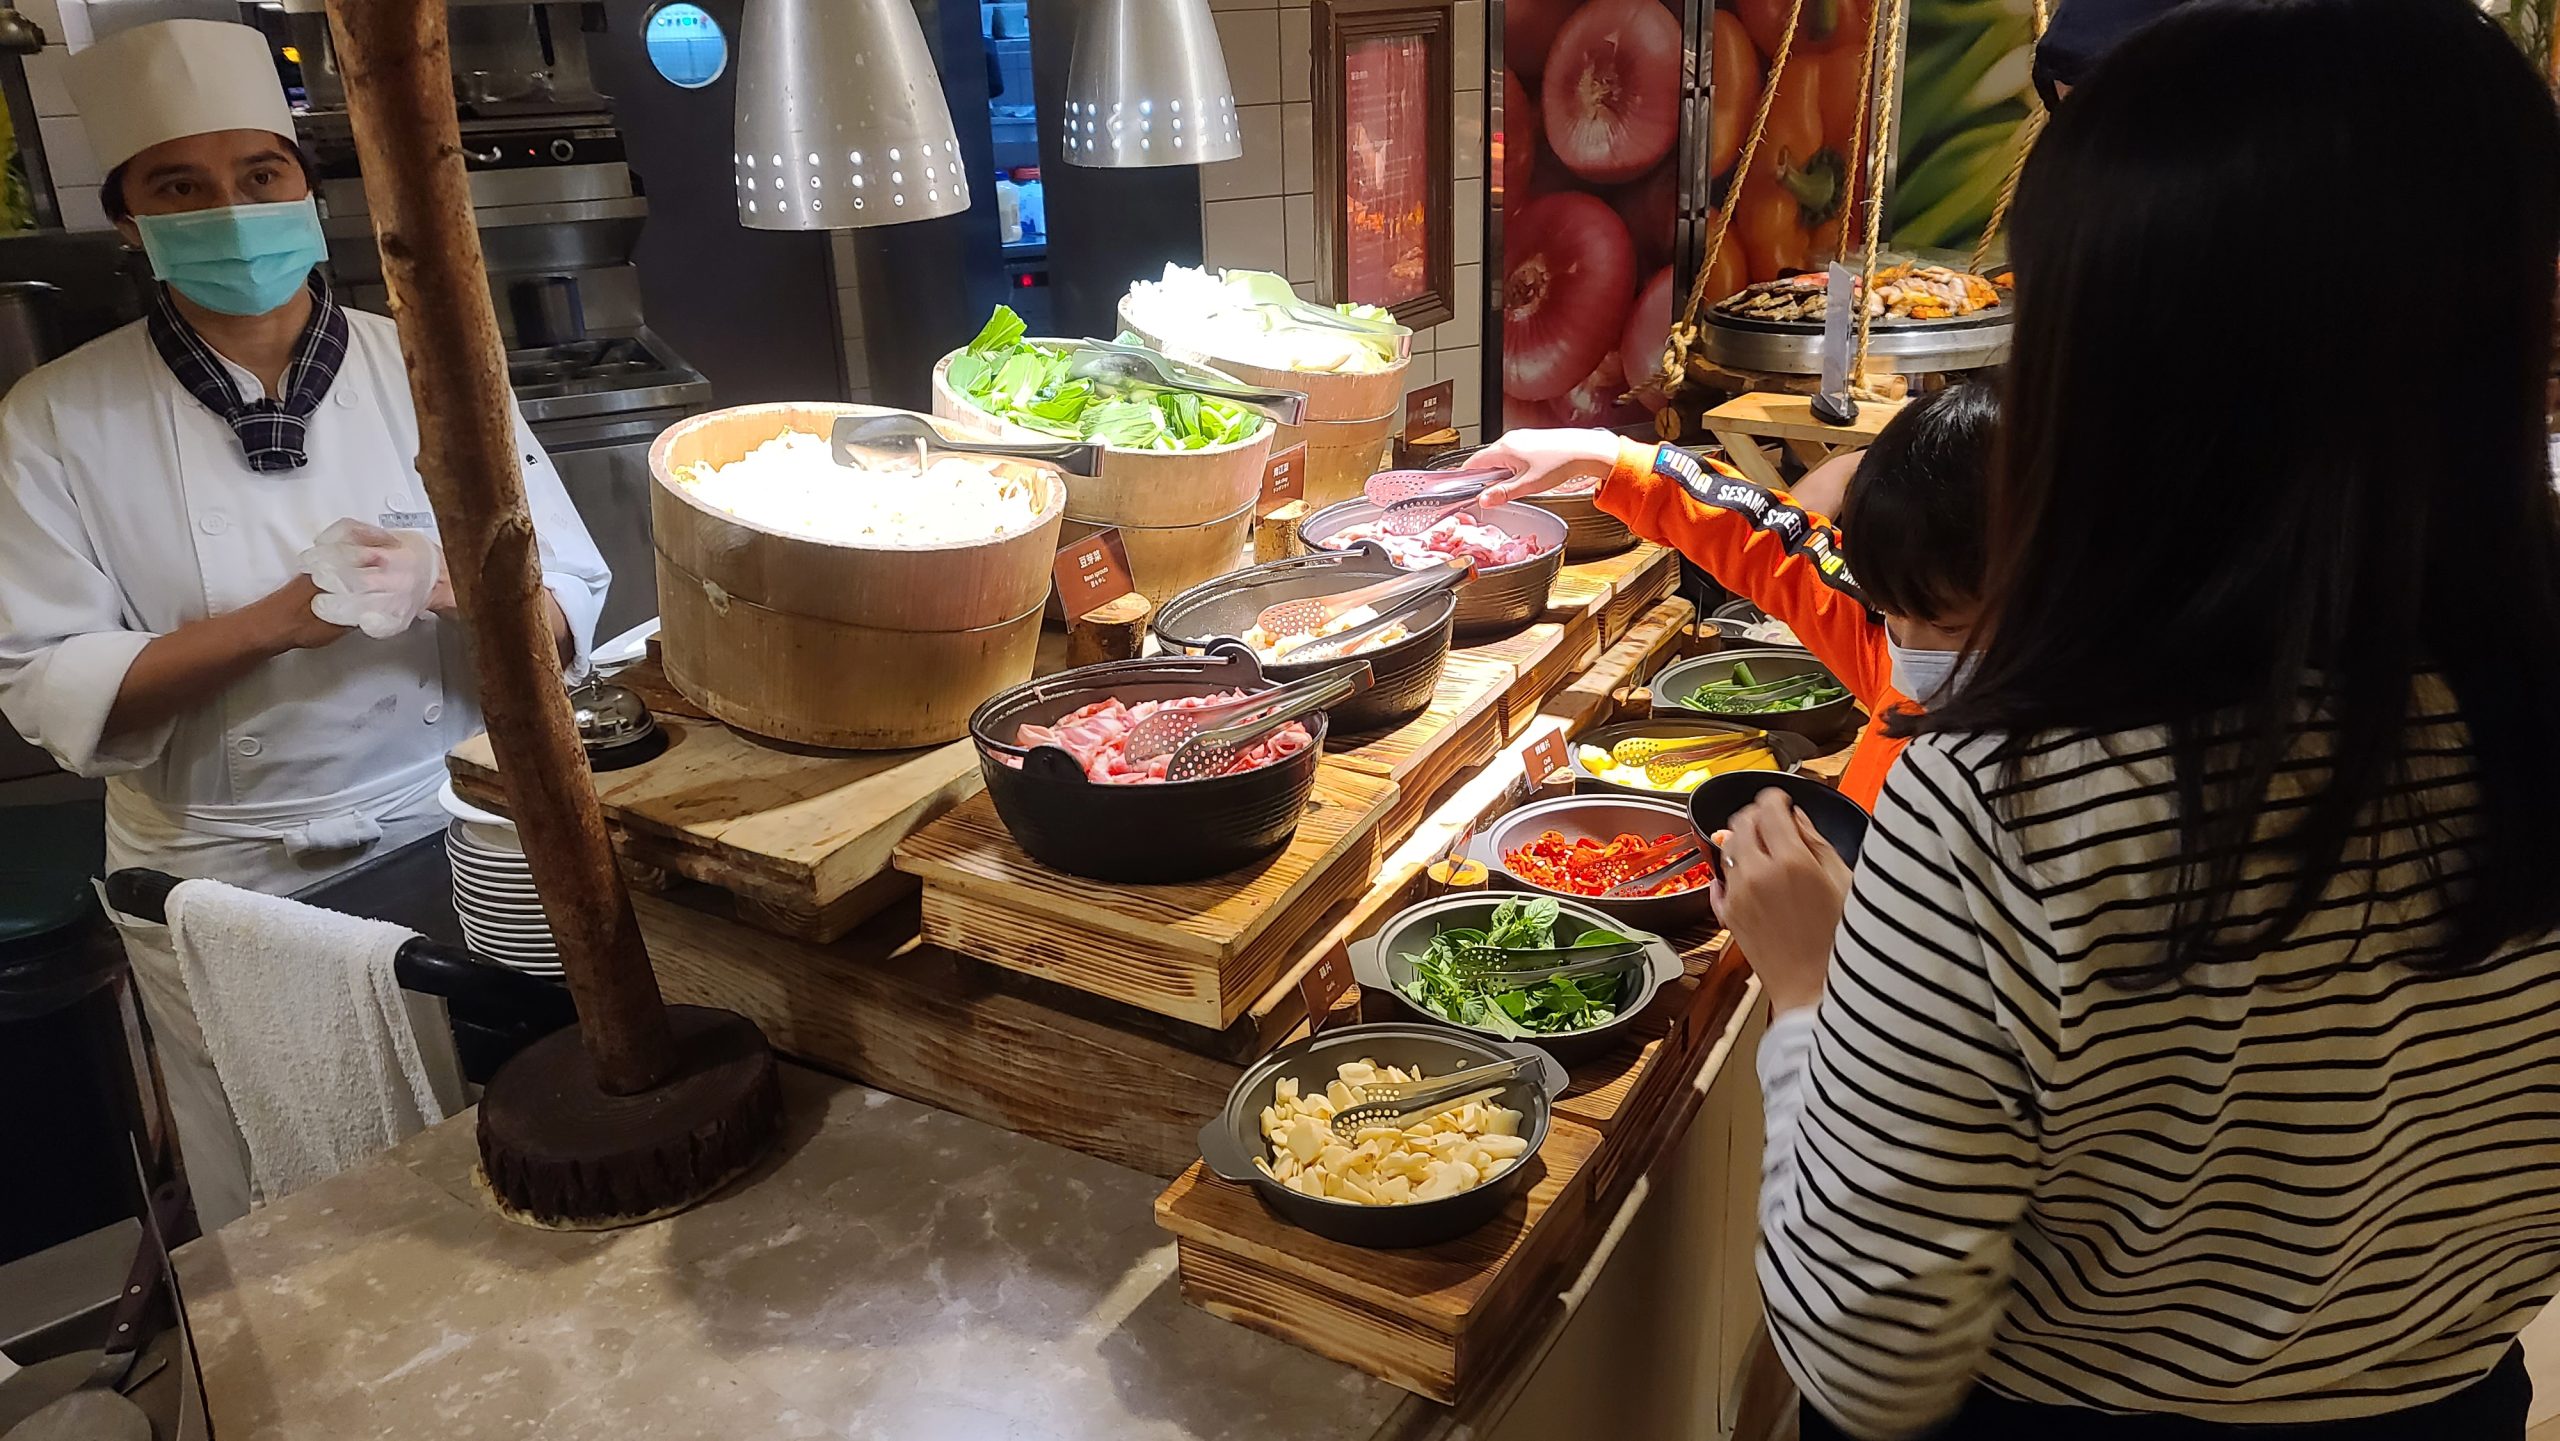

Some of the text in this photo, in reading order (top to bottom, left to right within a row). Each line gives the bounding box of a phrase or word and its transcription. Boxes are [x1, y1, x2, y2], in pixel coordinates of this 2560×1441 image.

[1656, 448, 1713, 494] PUMA
[1717, 484, 1769, 519] SESAME
[1763, 508, 1802, 542] STREET
[1078, 549, 1102, 569] 豆芽菜
